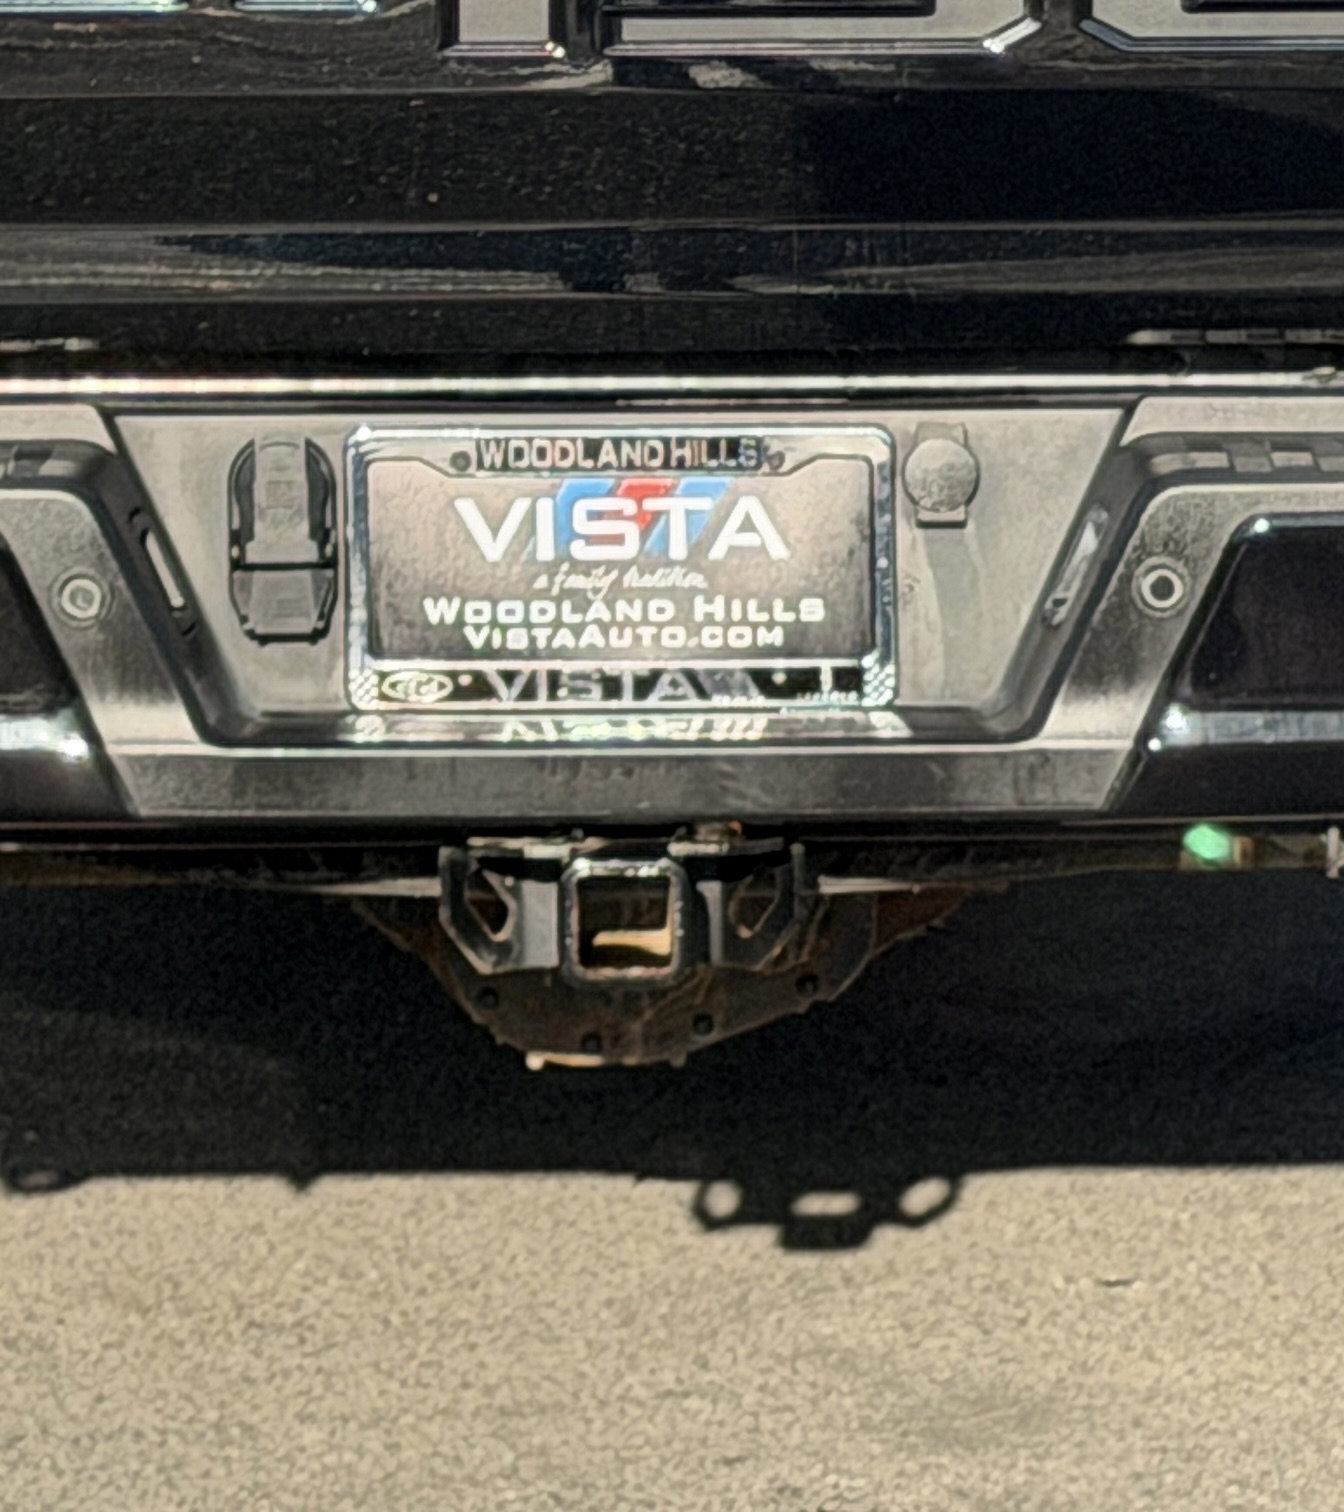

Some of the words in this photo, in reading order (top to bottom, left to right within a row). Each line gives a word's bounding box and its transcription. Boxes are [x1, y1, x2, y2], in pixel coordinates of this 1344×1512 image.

[480, 438, 664, 469] WOODLAND
[670, 438, 758, 468] HILLS
[455, 495, 791, 562] VISTA
[486, 667, 698, 703] VISTA
